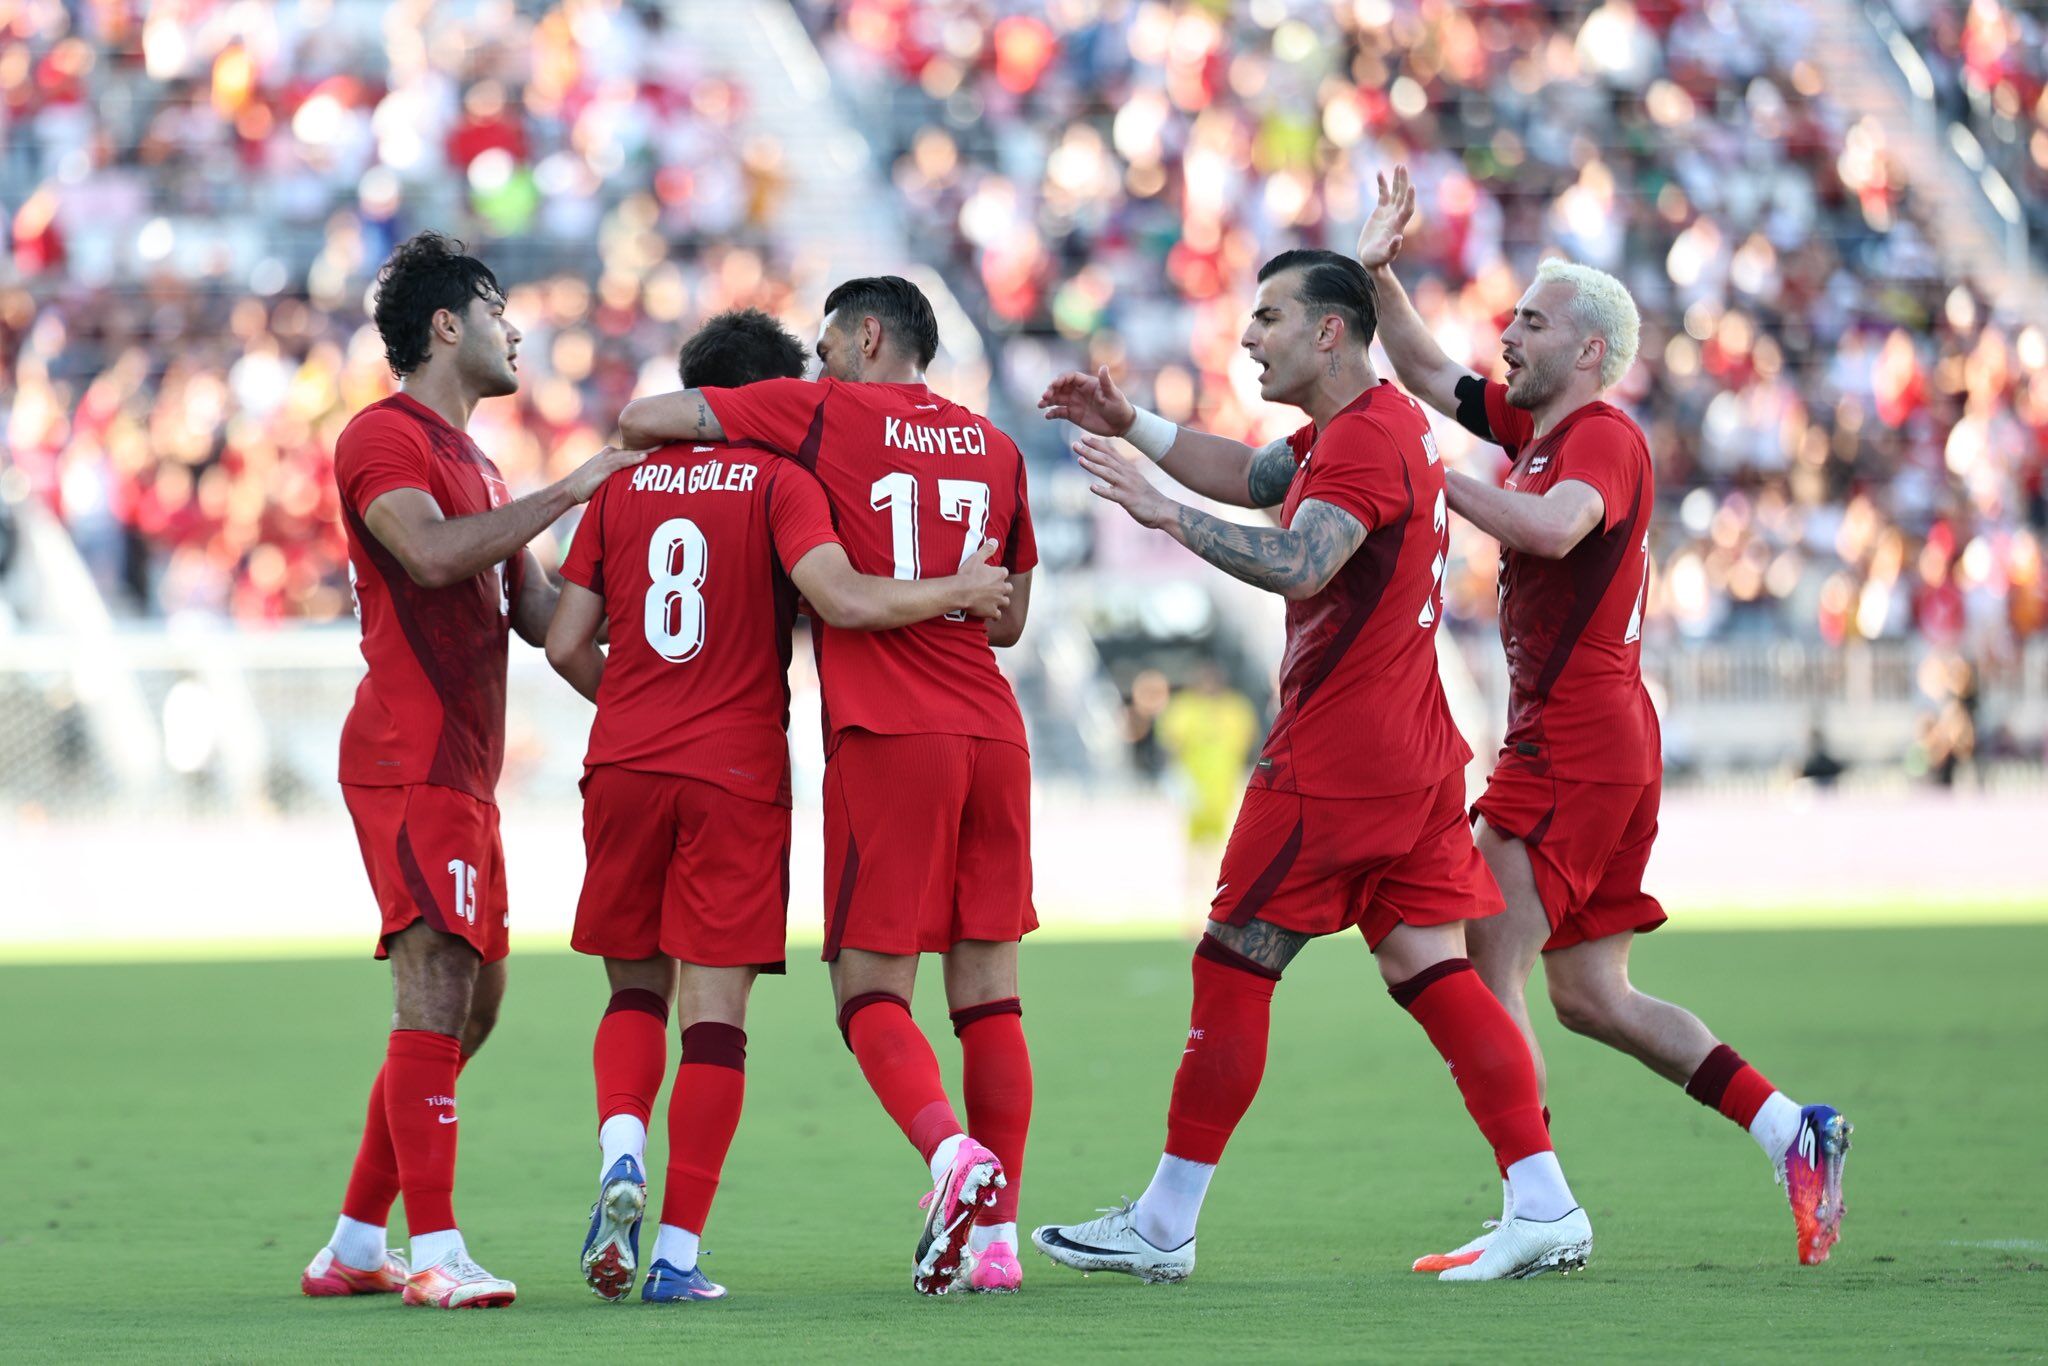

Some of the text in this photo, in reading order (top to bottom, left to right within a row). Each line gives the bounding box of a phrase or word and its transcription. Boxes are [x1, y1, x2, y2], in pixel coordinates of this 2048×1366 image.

[885, 416, 987, 456] KAHVECİ
[628, 459, 758, 494] ARDA GÜLER
[870, 472, 990, 622] 17
[644, 518, 708, 664] 8
[448, 859, 477, 926] 15
[1189, 1026, 1205, 1039] İYE
